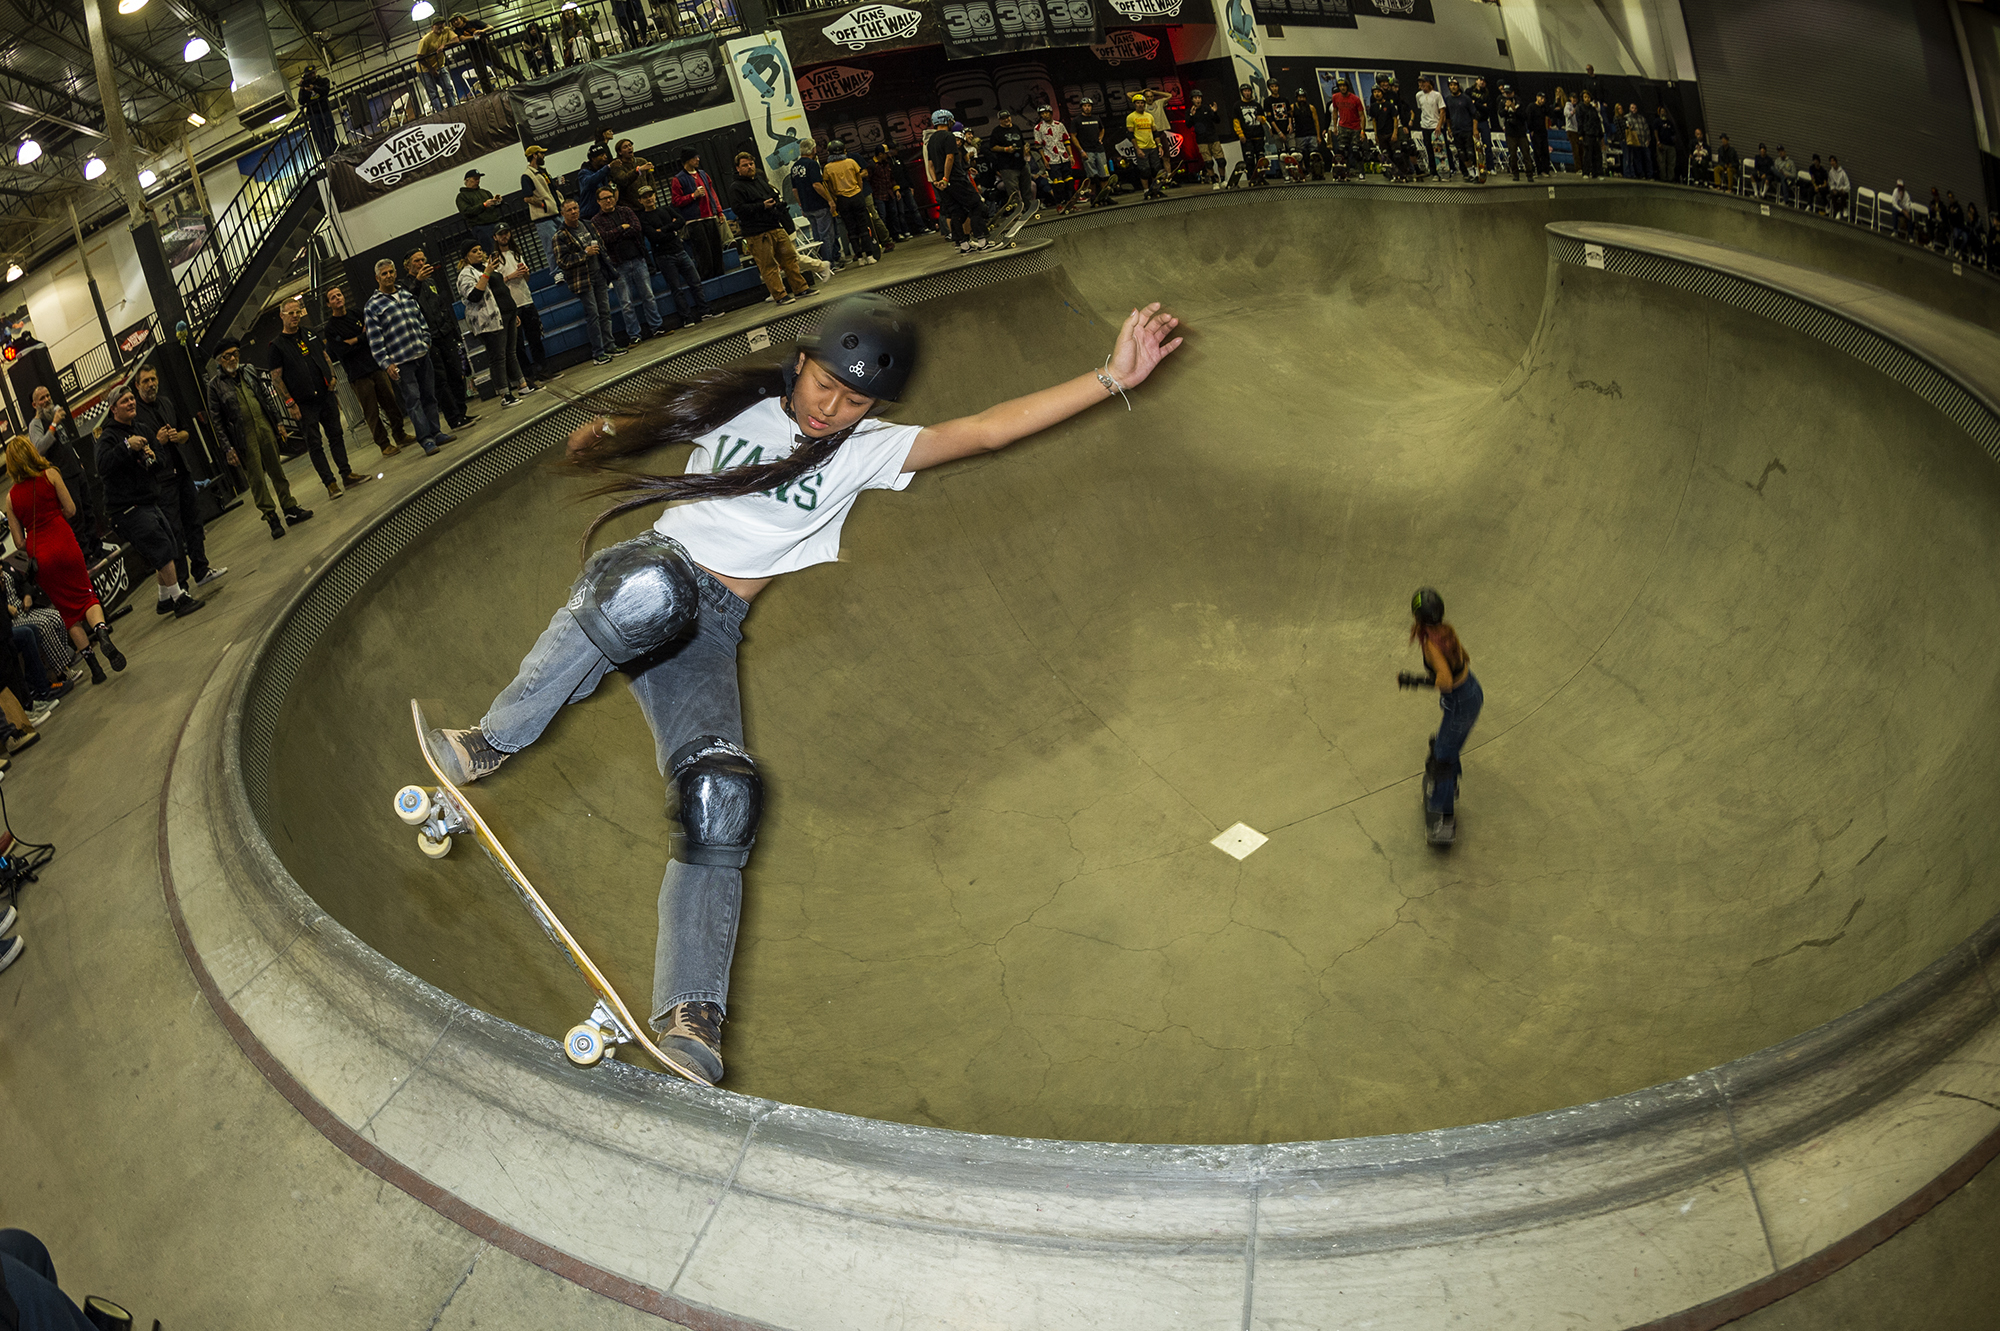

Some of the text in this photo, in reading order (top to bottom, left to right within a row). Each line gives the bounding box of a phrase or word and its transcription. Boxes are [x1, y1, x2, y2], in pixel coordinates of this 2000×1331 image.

[849, 6, 886, 24] VANS
[1136, 0, 1158, 13] THE
[830, 11, 916, 40] "OFF THE WALL"
[1109, 32, 1135, 45] VANS
[1115, 42, 1136, 57] THE
[806, 67, 841, 86] VANS
[814, 81, 841, 99] THE
[384, 126, 426, 154] VANS
[364, 124, 460, 178] "OFF THE WALL"
[712, 434, 824, 511] VAS
